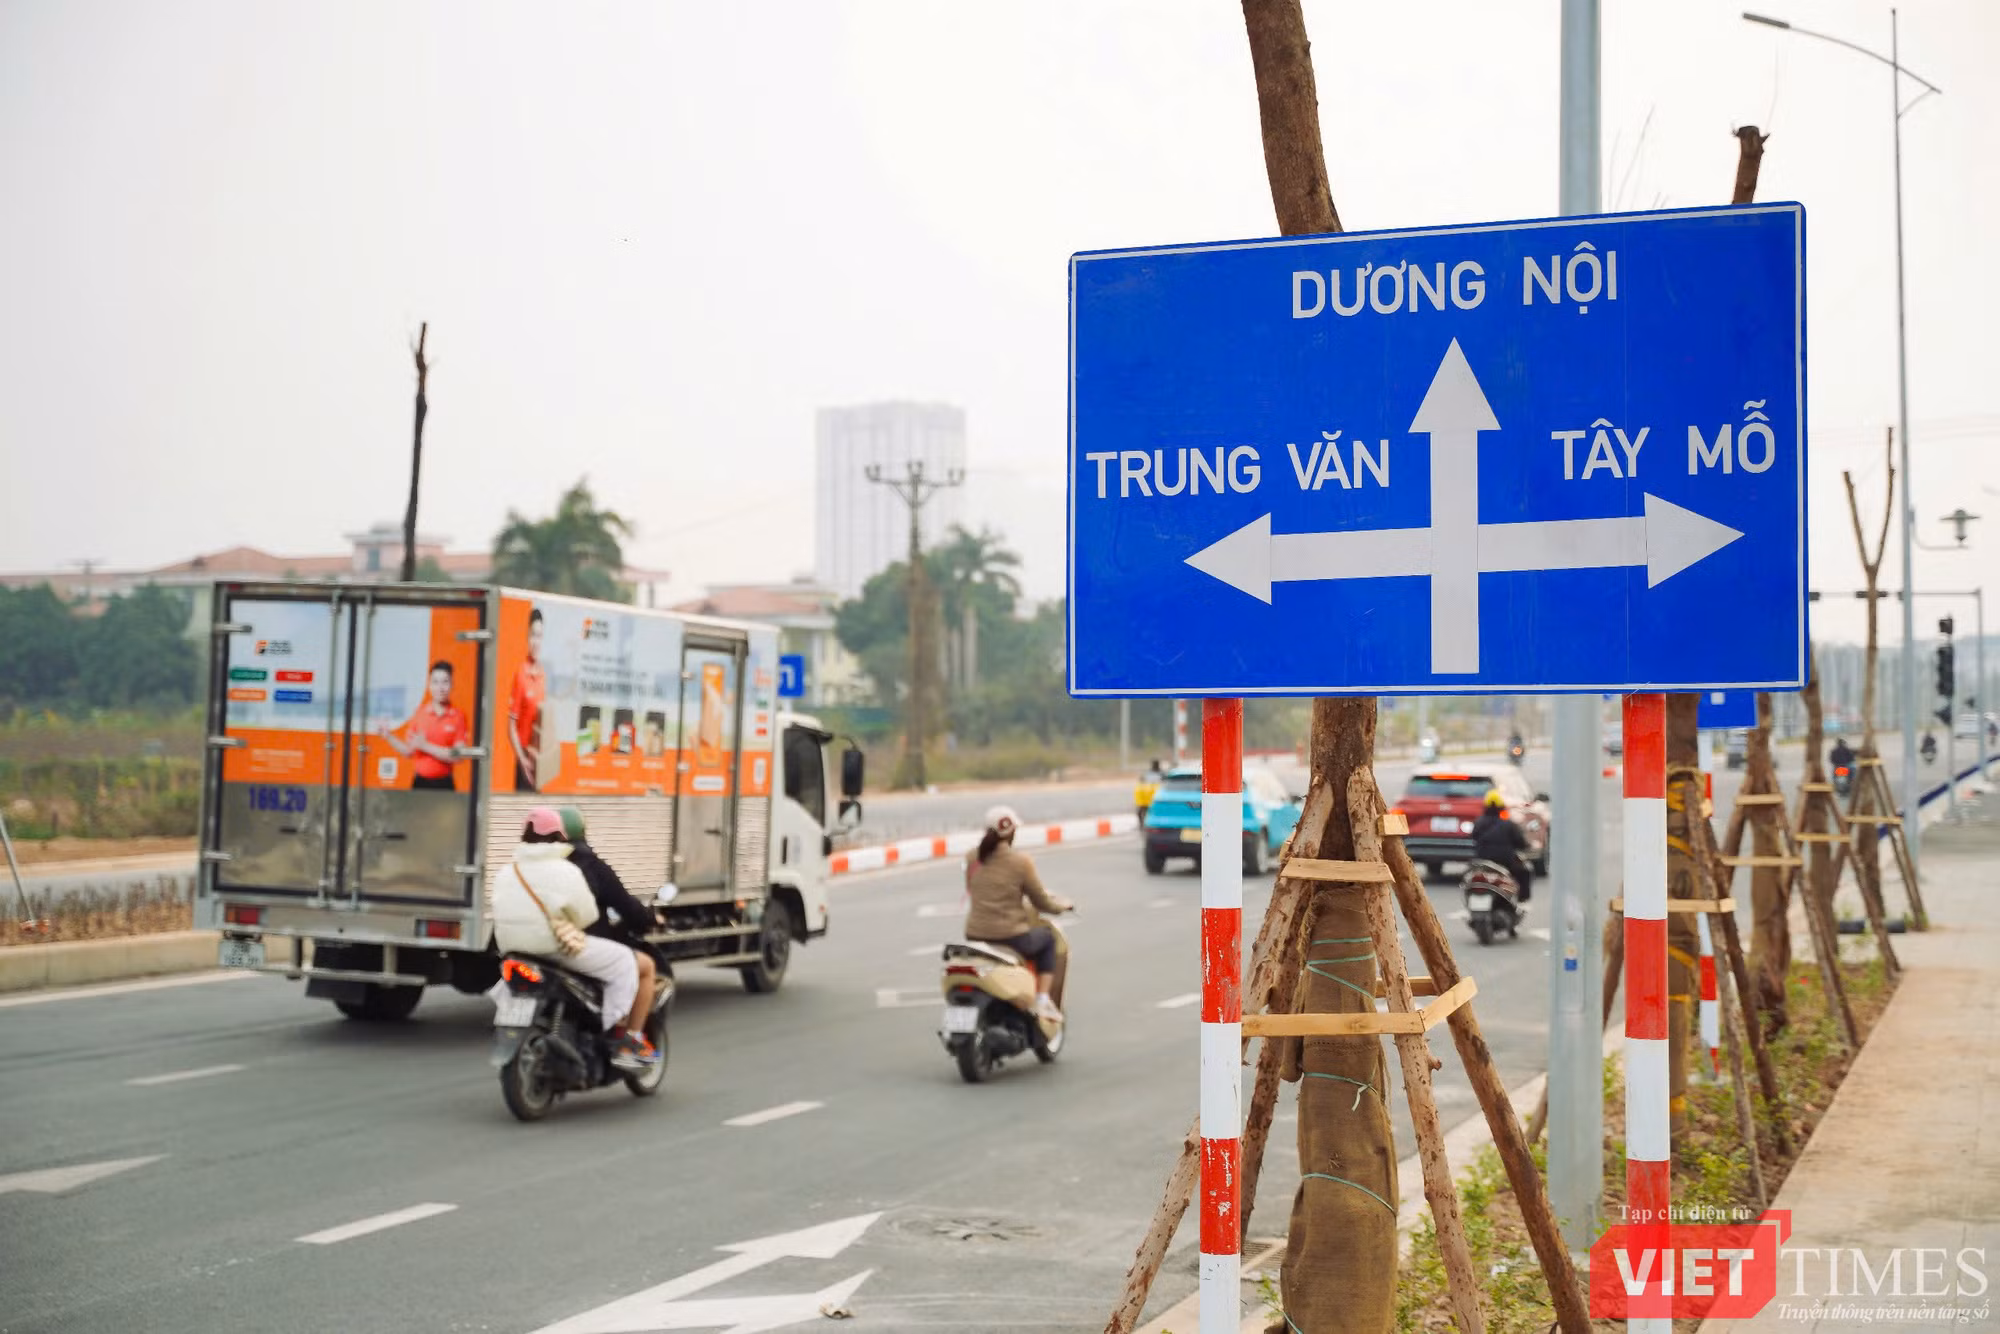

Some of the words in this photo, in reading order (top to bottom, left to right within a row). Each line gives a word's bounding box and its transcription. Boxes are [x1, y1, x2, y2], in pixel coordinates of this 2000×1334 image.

[1292, 261, 1486, 319] DƯƠNG
[1523, 241, 1617, 315] NỘI
[1086, 446, 1261, 499] TRUNG
[1287, 430, 1390, 491] VĂN
[1551, 417, 1651, 481] TÂY
[1687, 399, 1776, 475] MỖ
